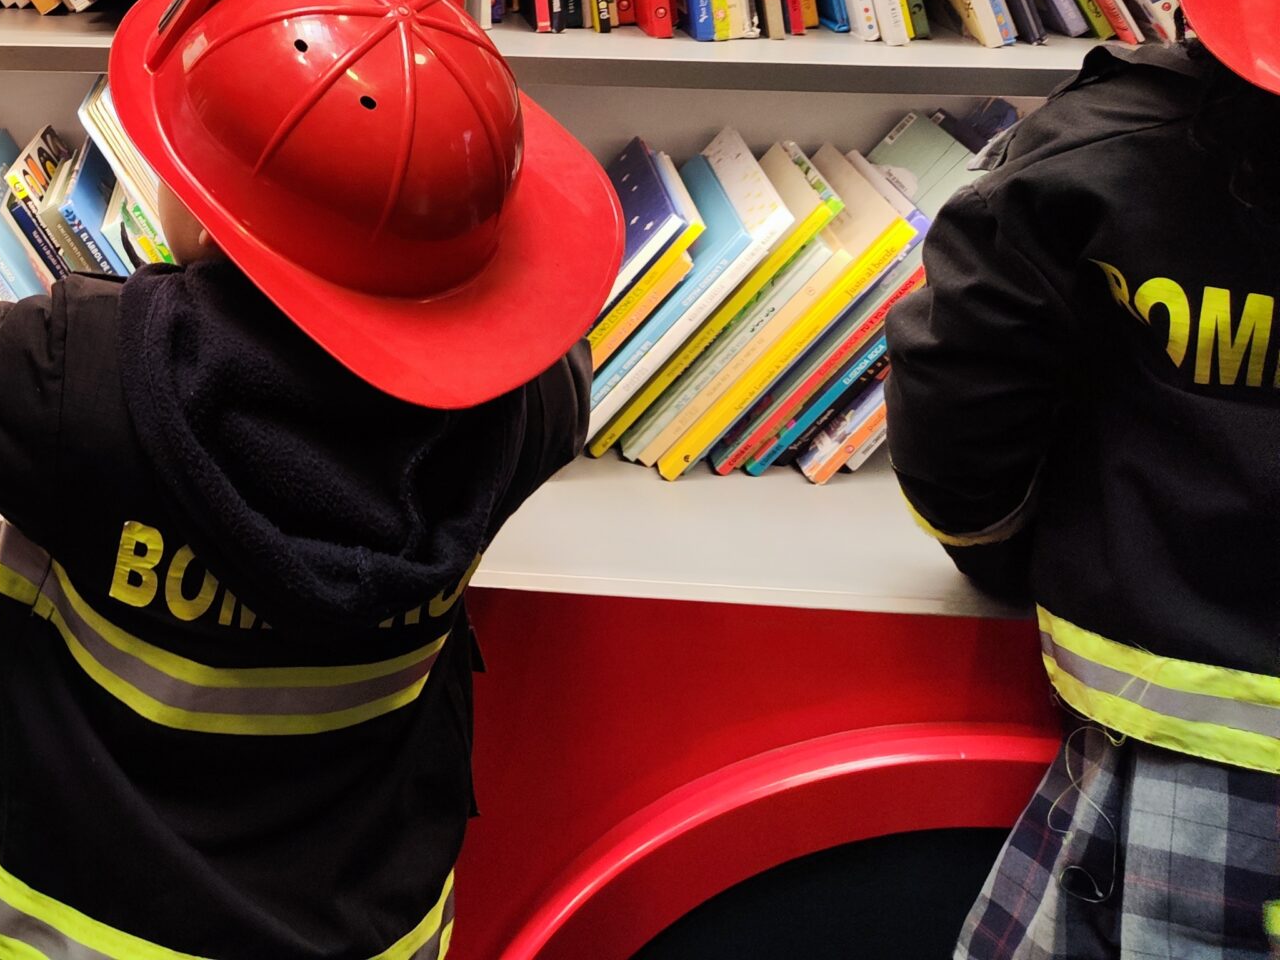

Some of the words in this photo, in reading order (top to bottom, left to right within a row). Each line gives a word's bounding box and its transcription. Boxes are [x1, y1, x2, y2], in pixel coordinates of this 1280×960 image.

[79, 230, 90, 241] EL
[84, 237, 105, 262] ÁRBOL
[98, 259, 111, 272] DE
[843, 274, 869, 299] Justo
[862, 265, 875, 278] al
[870, 244, 897, 270] borde
